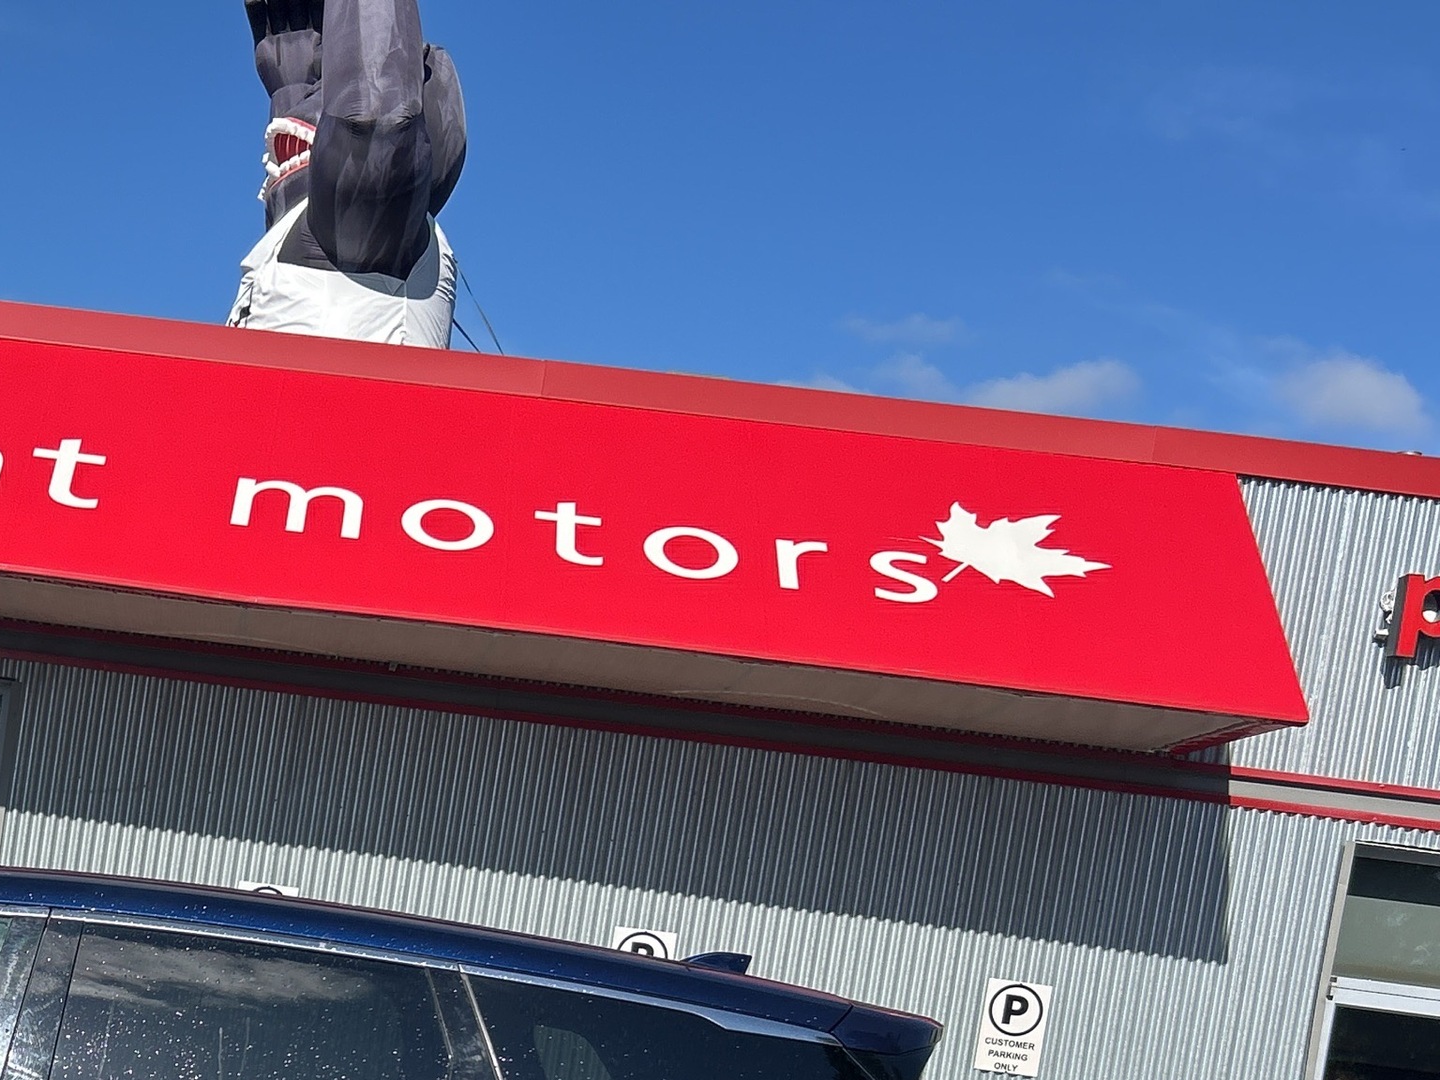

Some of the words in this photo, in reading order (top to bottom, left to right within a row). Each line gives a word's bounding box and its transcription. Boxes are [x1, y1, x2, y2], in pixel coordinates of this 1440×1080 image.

[229, 477, 939, 603] motors
[1001, 994, 1029, 1024] P
[985, 1037, 1035, 1050] CUSTOMER
[988, 1050, 1028, 1061] PARKING
[994, 1062, 1018, 1072] ONLY
